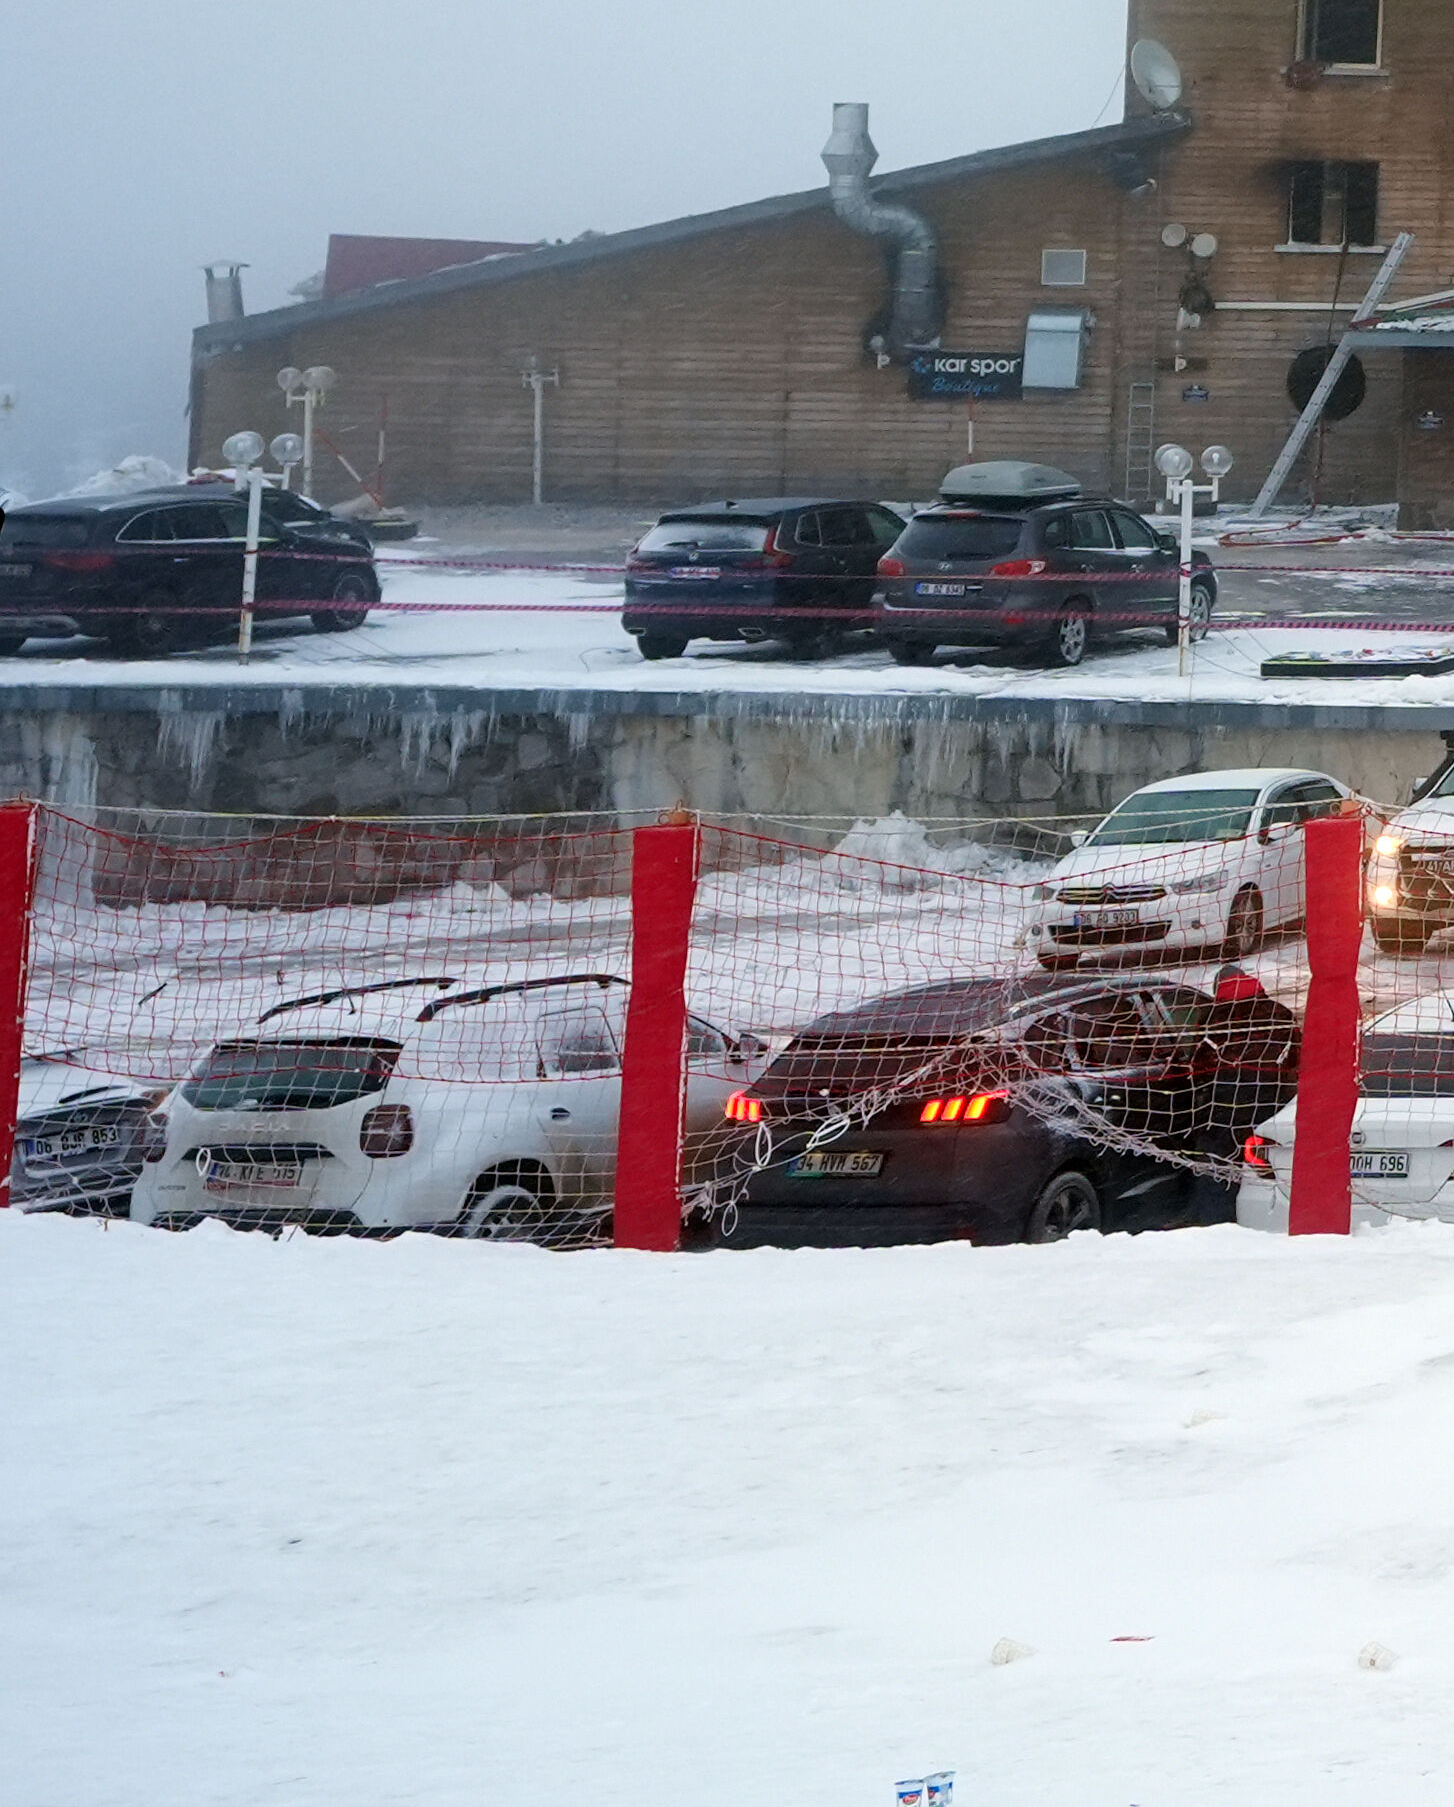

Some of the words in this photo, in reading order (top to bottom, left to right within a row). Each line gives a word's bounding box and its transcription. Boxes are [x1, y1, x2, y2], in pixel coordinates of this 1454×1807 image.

[934, 358, 967, 372] kar
[970, 358, 1021, 376] spor
[851, 1155, 879, 1171] 567
[1380, 1156, 1404, 1171] 696
